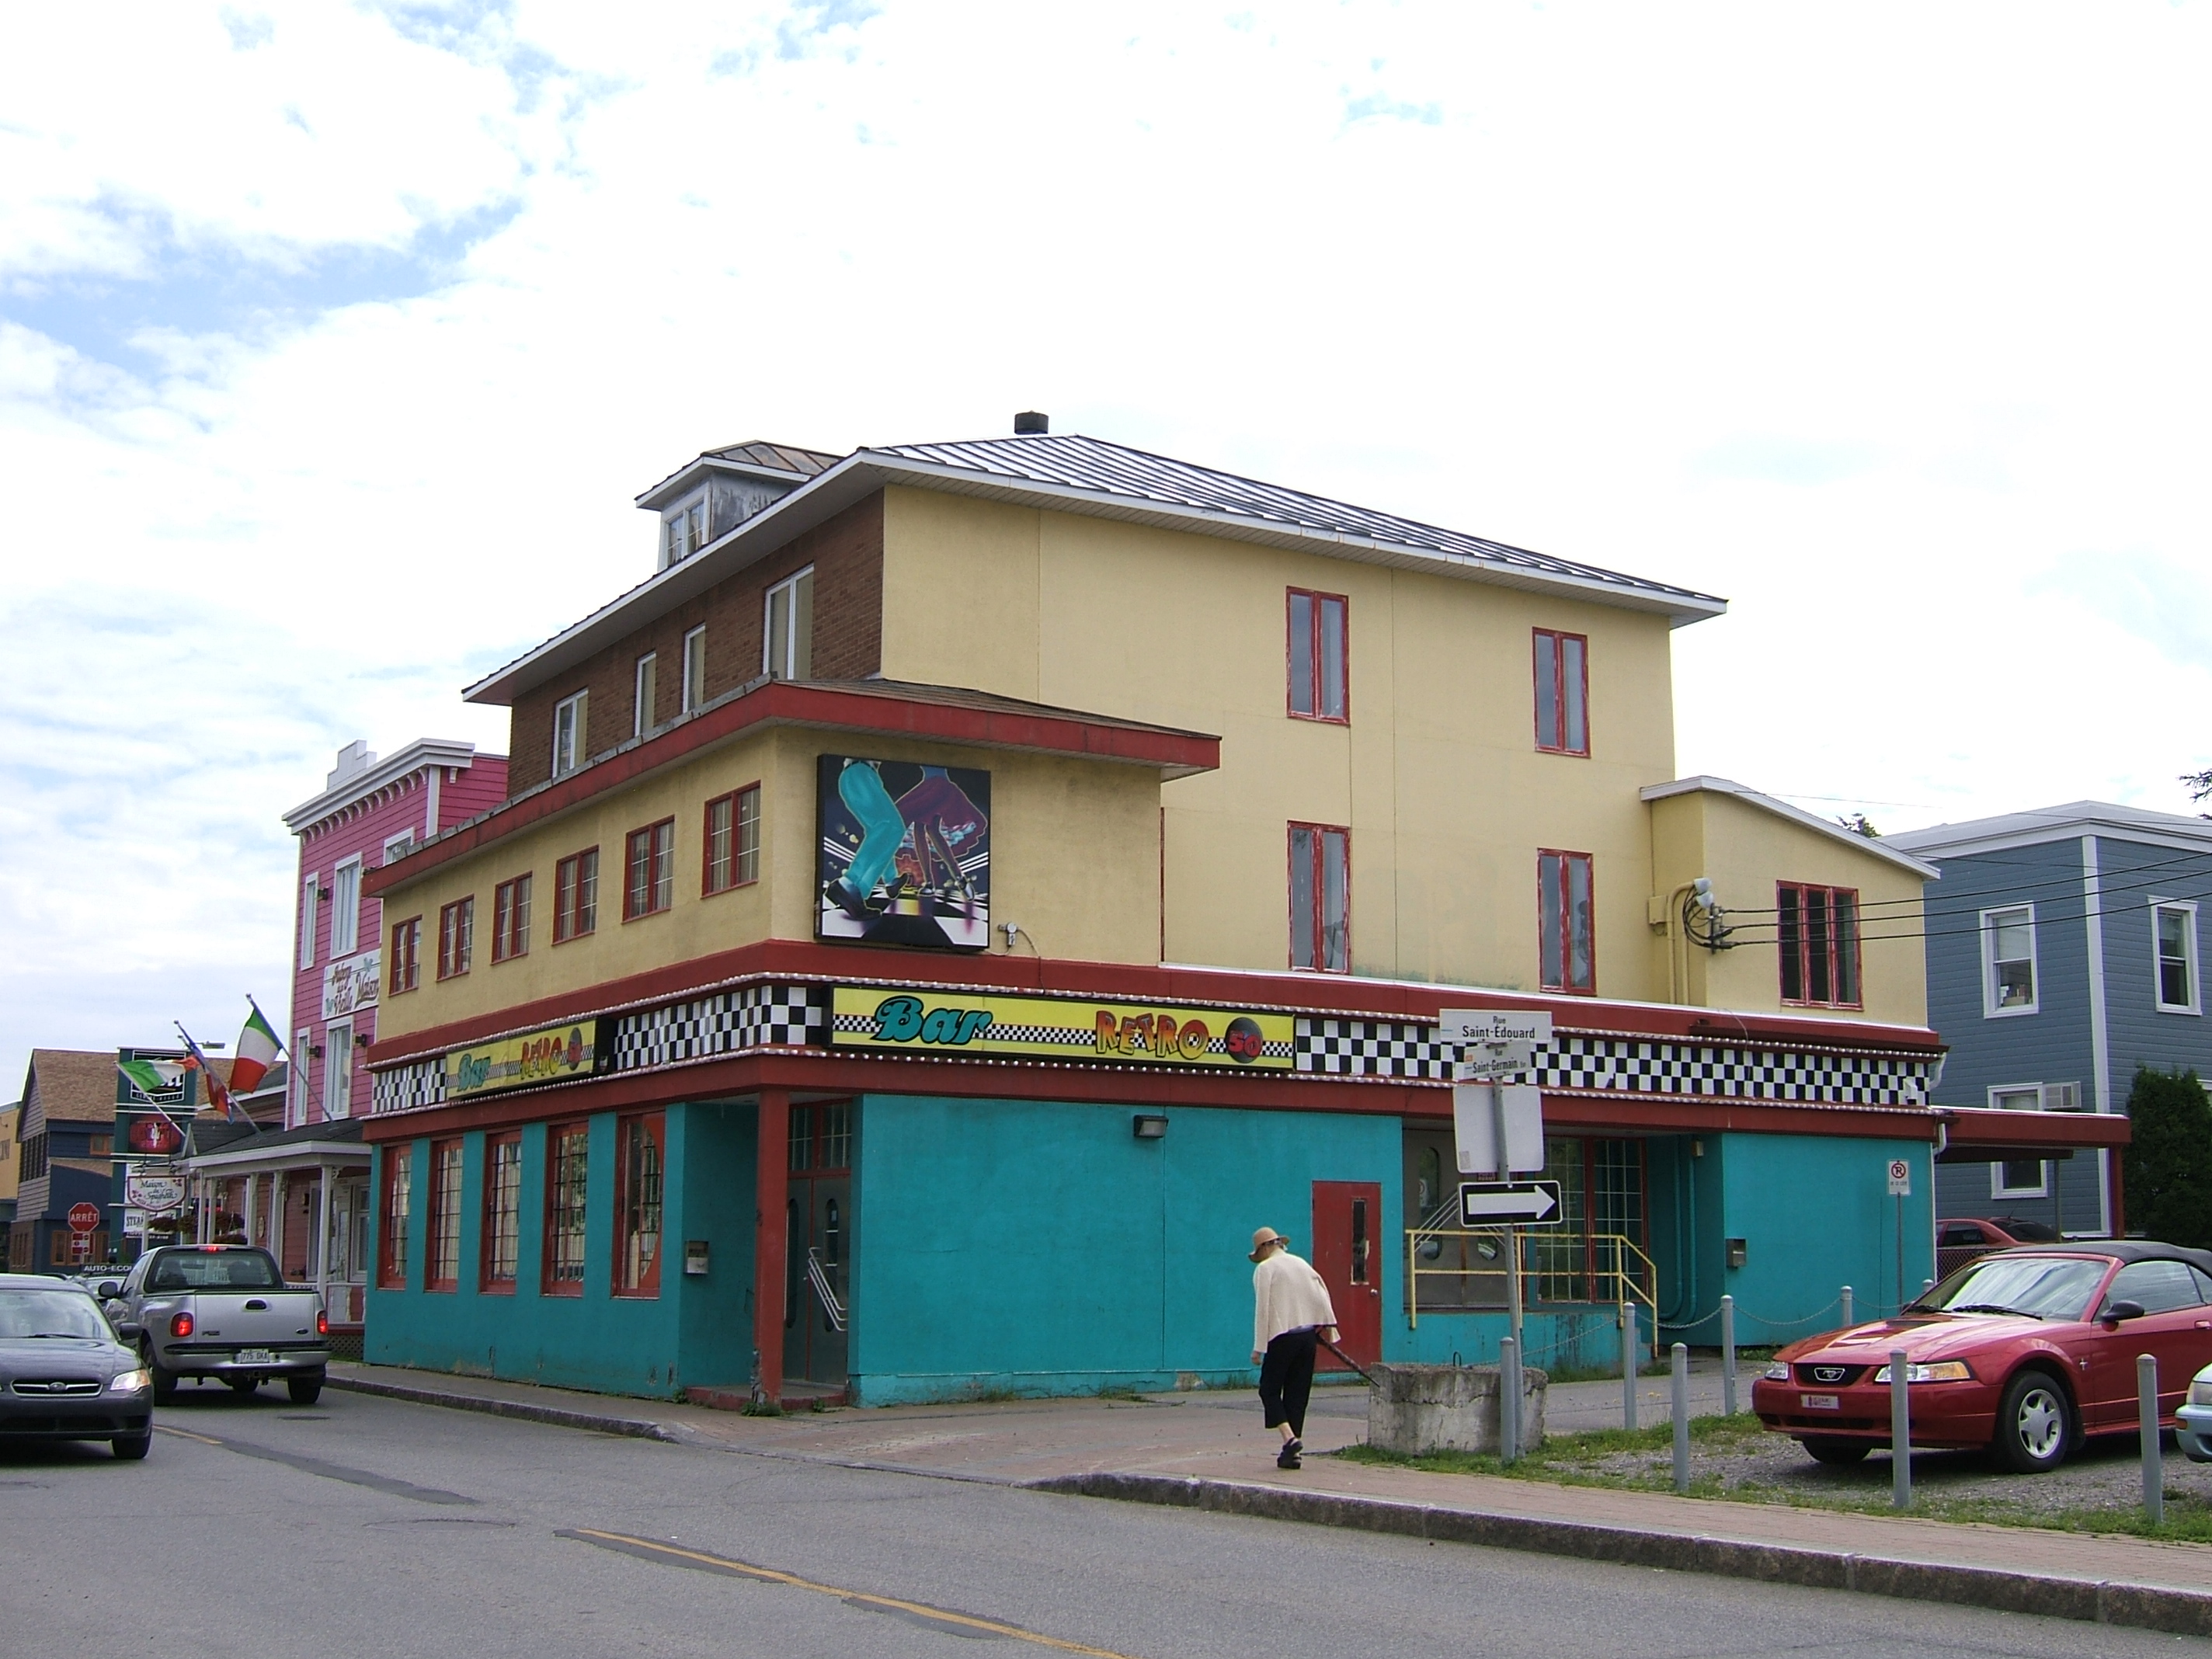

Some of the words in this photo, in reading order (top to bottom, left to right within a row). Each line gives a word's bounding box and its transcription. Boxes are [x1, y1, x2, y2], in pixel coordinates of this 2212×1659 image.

[870, 995, 993, 1045] Bar
[1096, 1010, 1209, 1059] RETRO
[1229, 1030, 1261, 1057] 50
[1493, 1015, 1506, 1024] Rue
[1462, 1024, 1536, 1038] Saint-Édouard
[457, 1053, 491, 1092] Bar
[1473, 1057, 1518, 1073] Saint-Germain
[71, 1212, 98, 1222] ARRÊT
